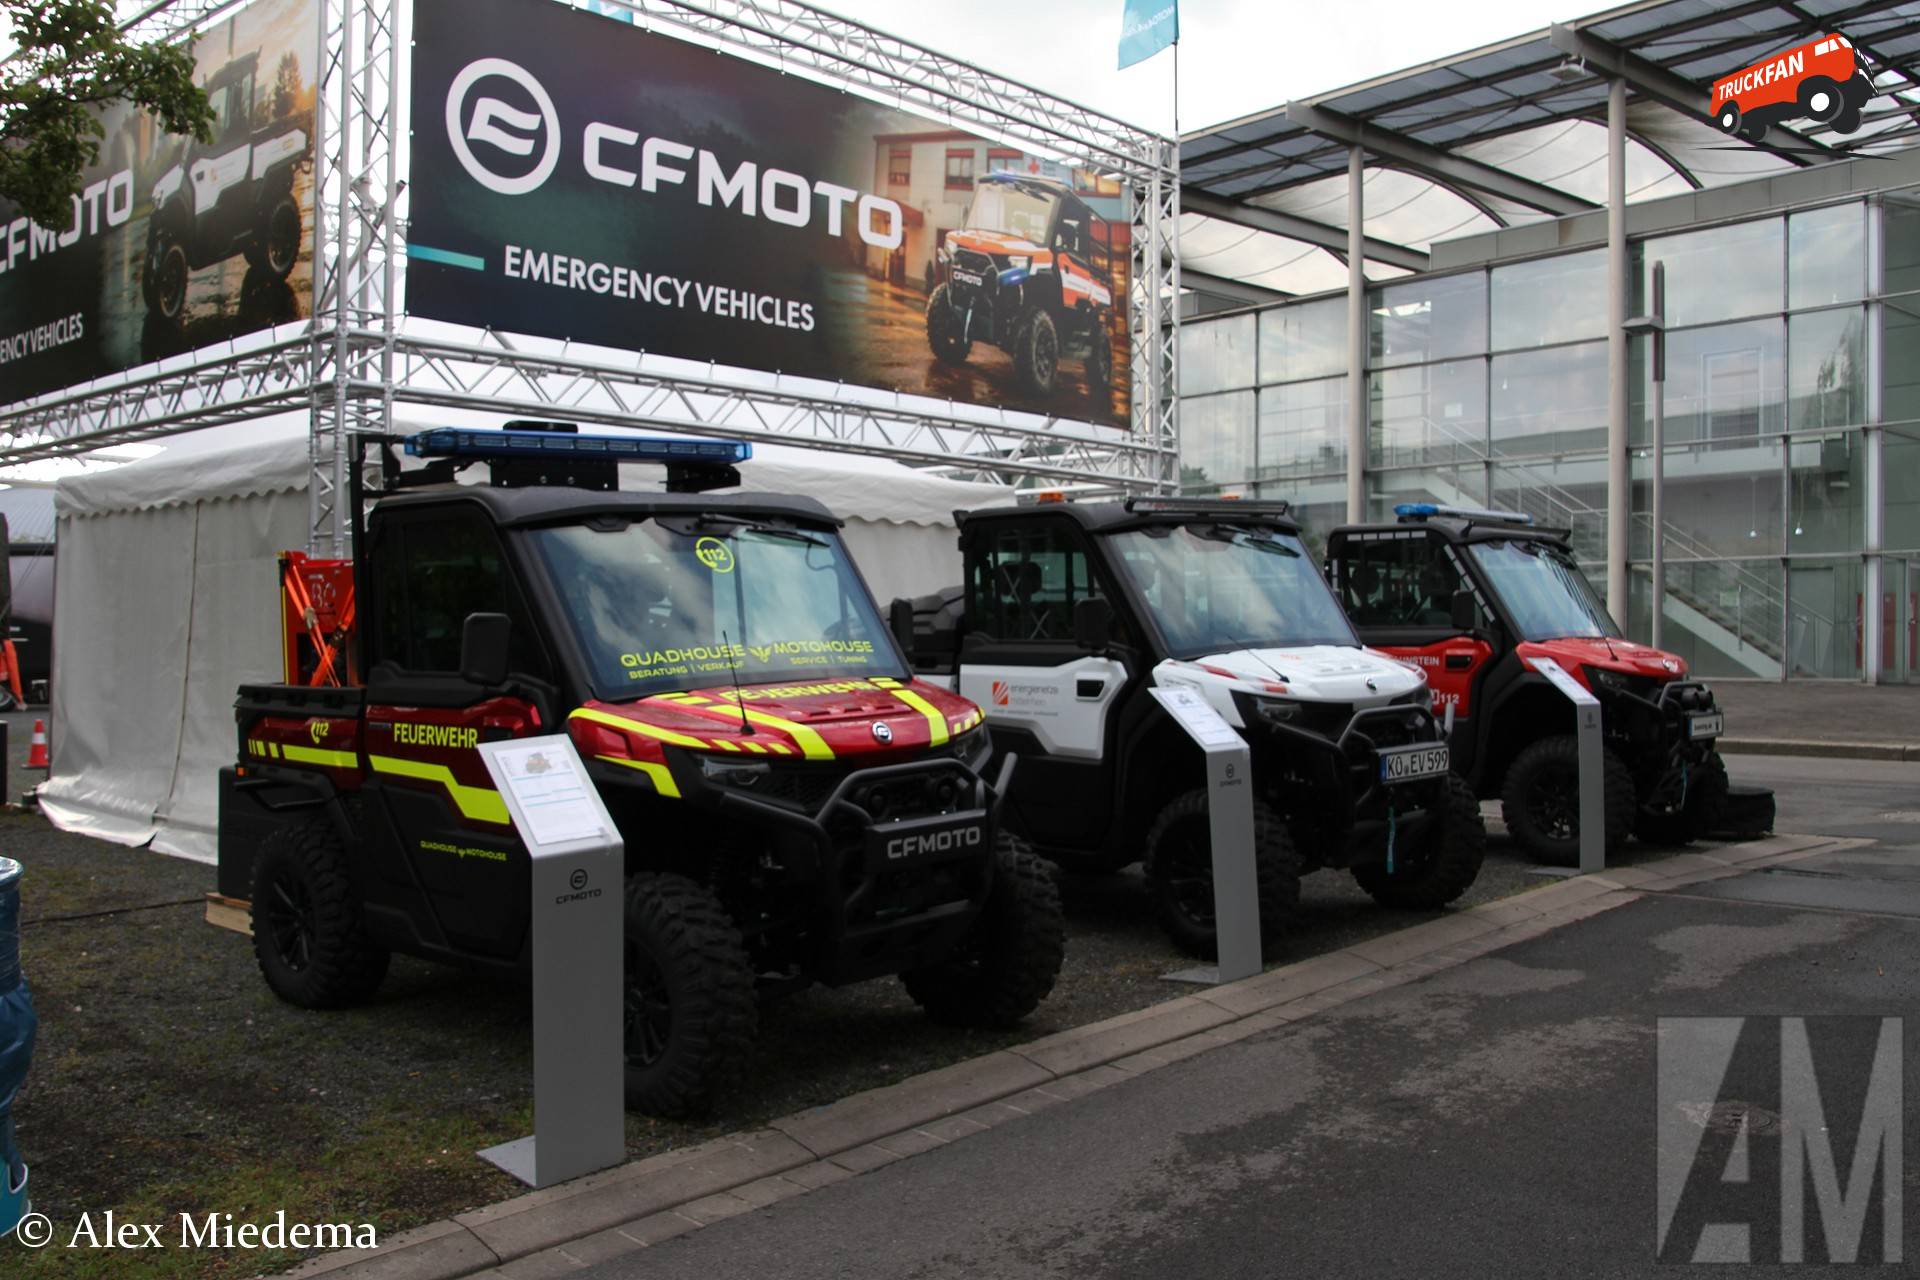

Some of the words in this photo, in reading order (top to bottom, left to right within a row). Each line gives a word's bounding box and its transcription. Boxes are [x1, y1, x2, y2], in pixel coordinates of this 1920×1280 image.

[581, 120, 904, 250] CFMOTO
[504, 244, 693, 309] EMERGENCY
[695, 281, 815, 332] VEHICLES
[29, 312, 84, 354] VEHICLES
[703, 547, 728, 562] 112
[620, 644, 746, 668] QUADHOUSE
[774, 640, 875, 655] MOTOHOUSE
[790, 655, 828, 665] SERVICE
[628, 664, 688, 680] BERATUNG
[696, 660, 745, 672] VERKAUF
[1440, 692, 1460, 704] 112
[315, 721, 330, 737] 112
[393, 722, 478, 749] FEUERWEHR
[1410, 753, 1426, 773] EV
[1427, 749, 1448, 771] 599
[887, 825, 981, 859] CFMOTO
[555, 888, 603, 905] CFMOTO
